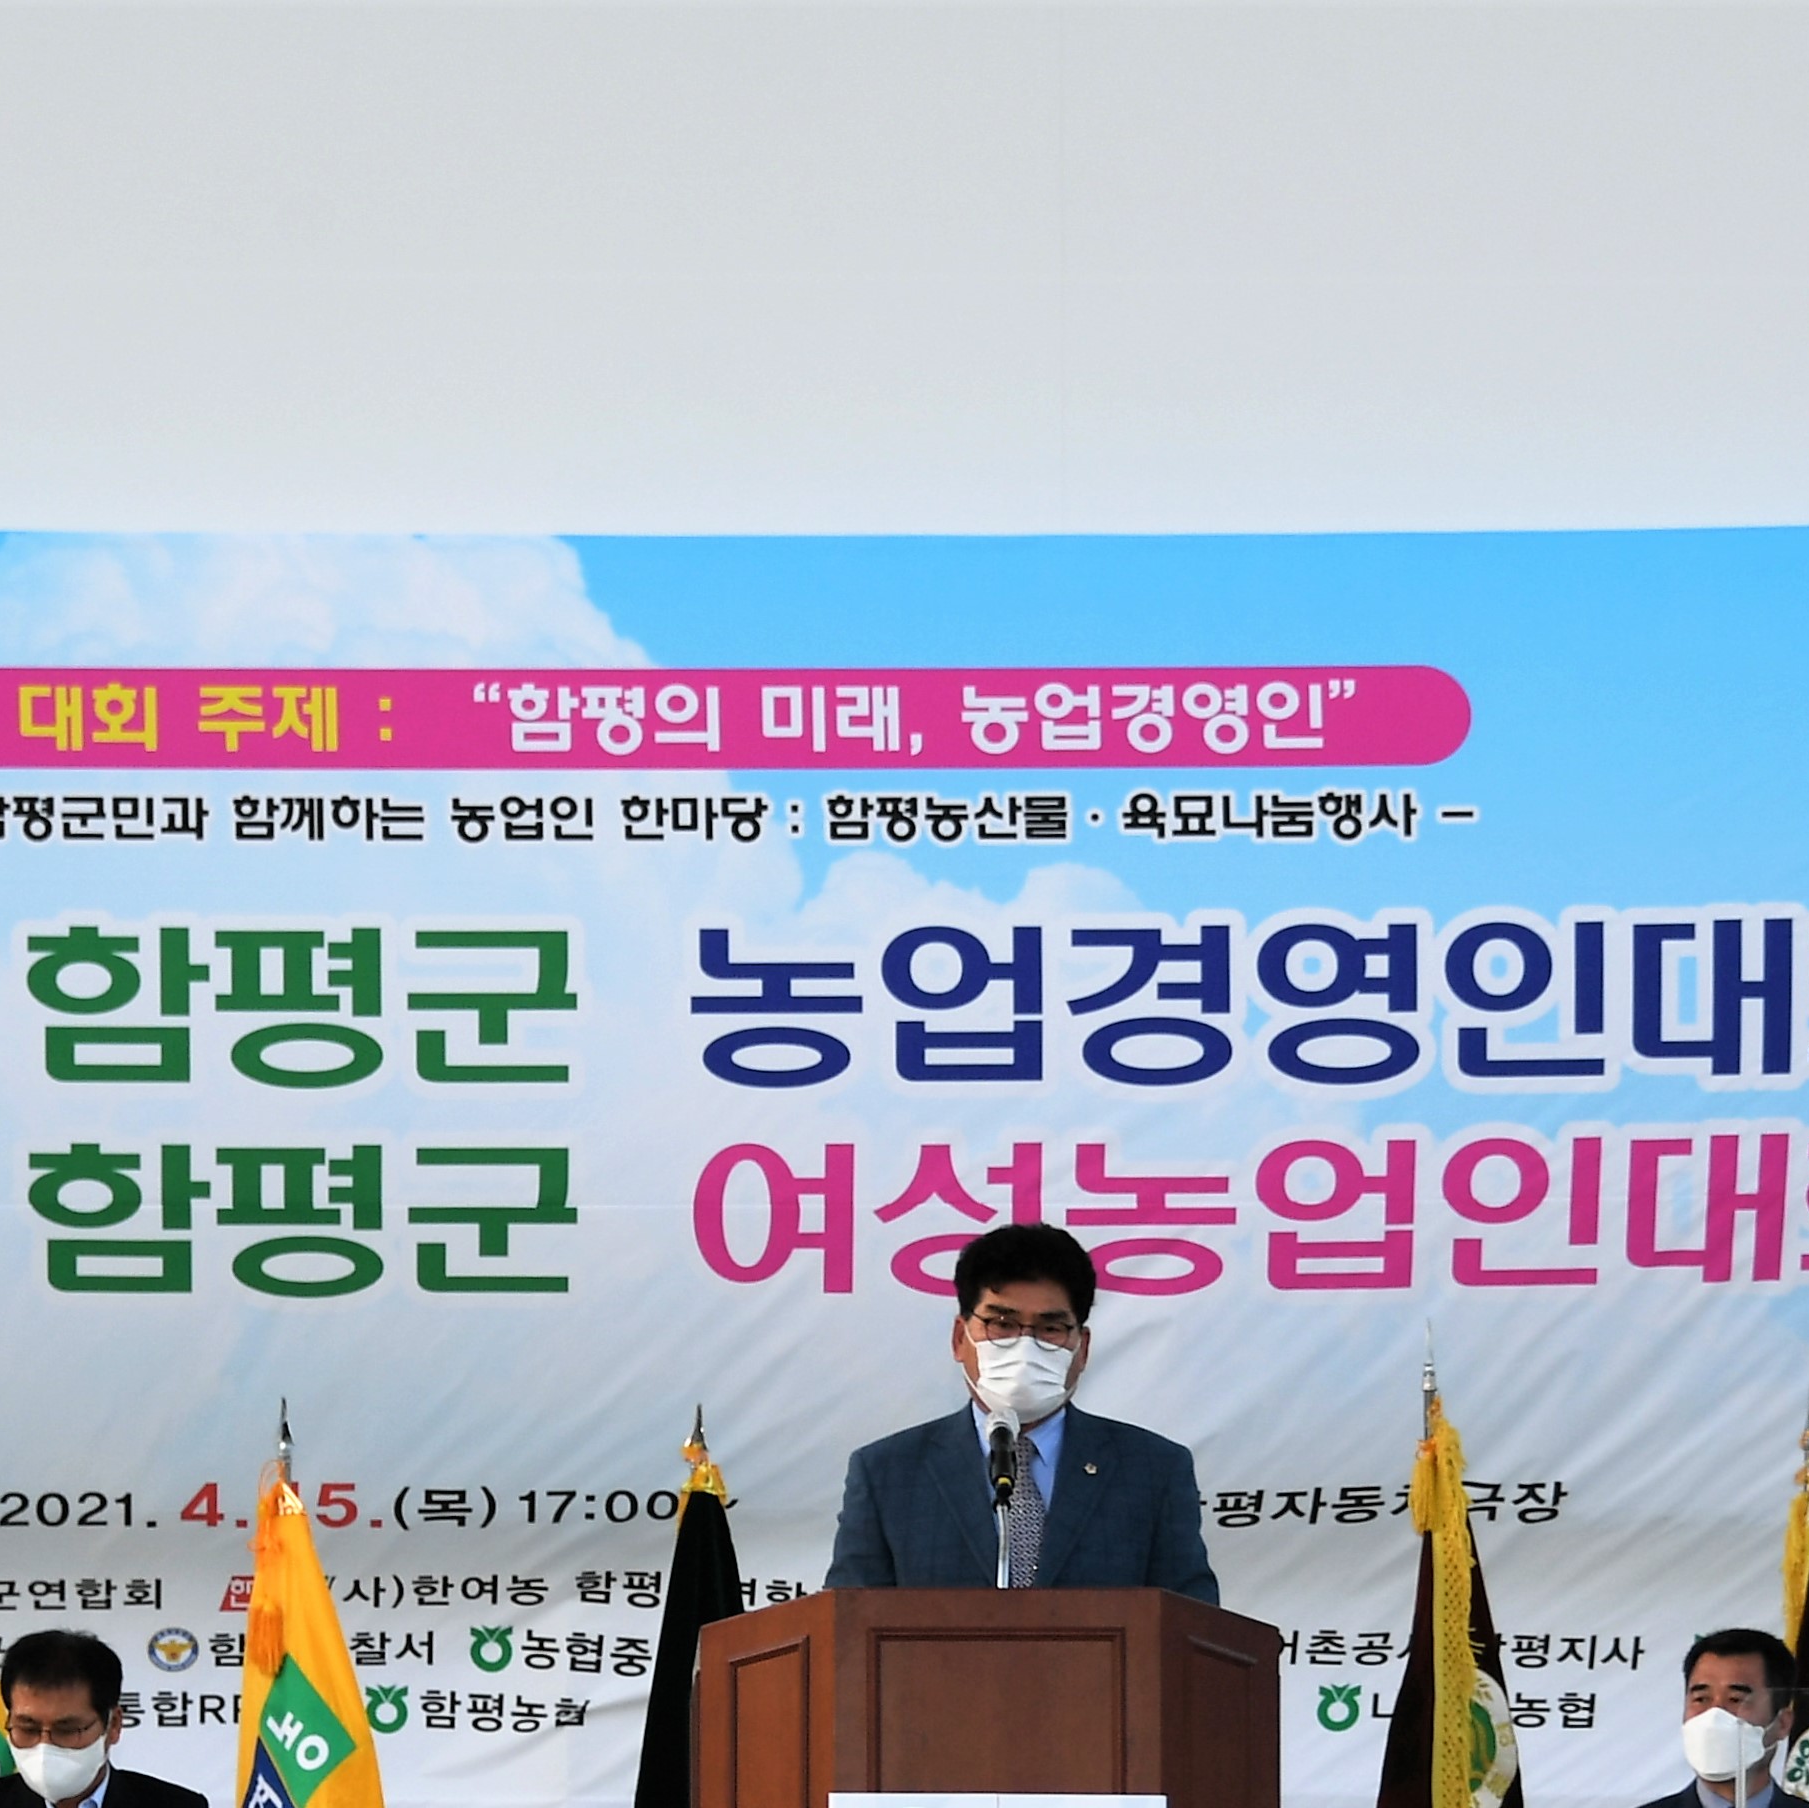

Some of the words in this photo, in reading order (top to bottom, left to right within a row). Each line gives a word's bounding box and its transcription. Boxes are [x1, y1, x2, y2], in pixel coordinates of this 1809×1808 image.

[19, 684, 159, 751] 대회
[199, 684, 339, 752] 주제
[761, 681, 923, 758] 미래,
[233, 793, 424, 842] 함께하는
[449, 793, 593, 842] 농업인
[618, 793, 766, 842] 한마당
[827, 793, 1068, 842] 함평농산물
[1121, 790, 1415, 842] 육묘나눔행사
[26, 926, 579, 1085] 함평군
[27, 1141, 579, 1296] 함평군
[0, 1491, 157, 1528] 2021.
